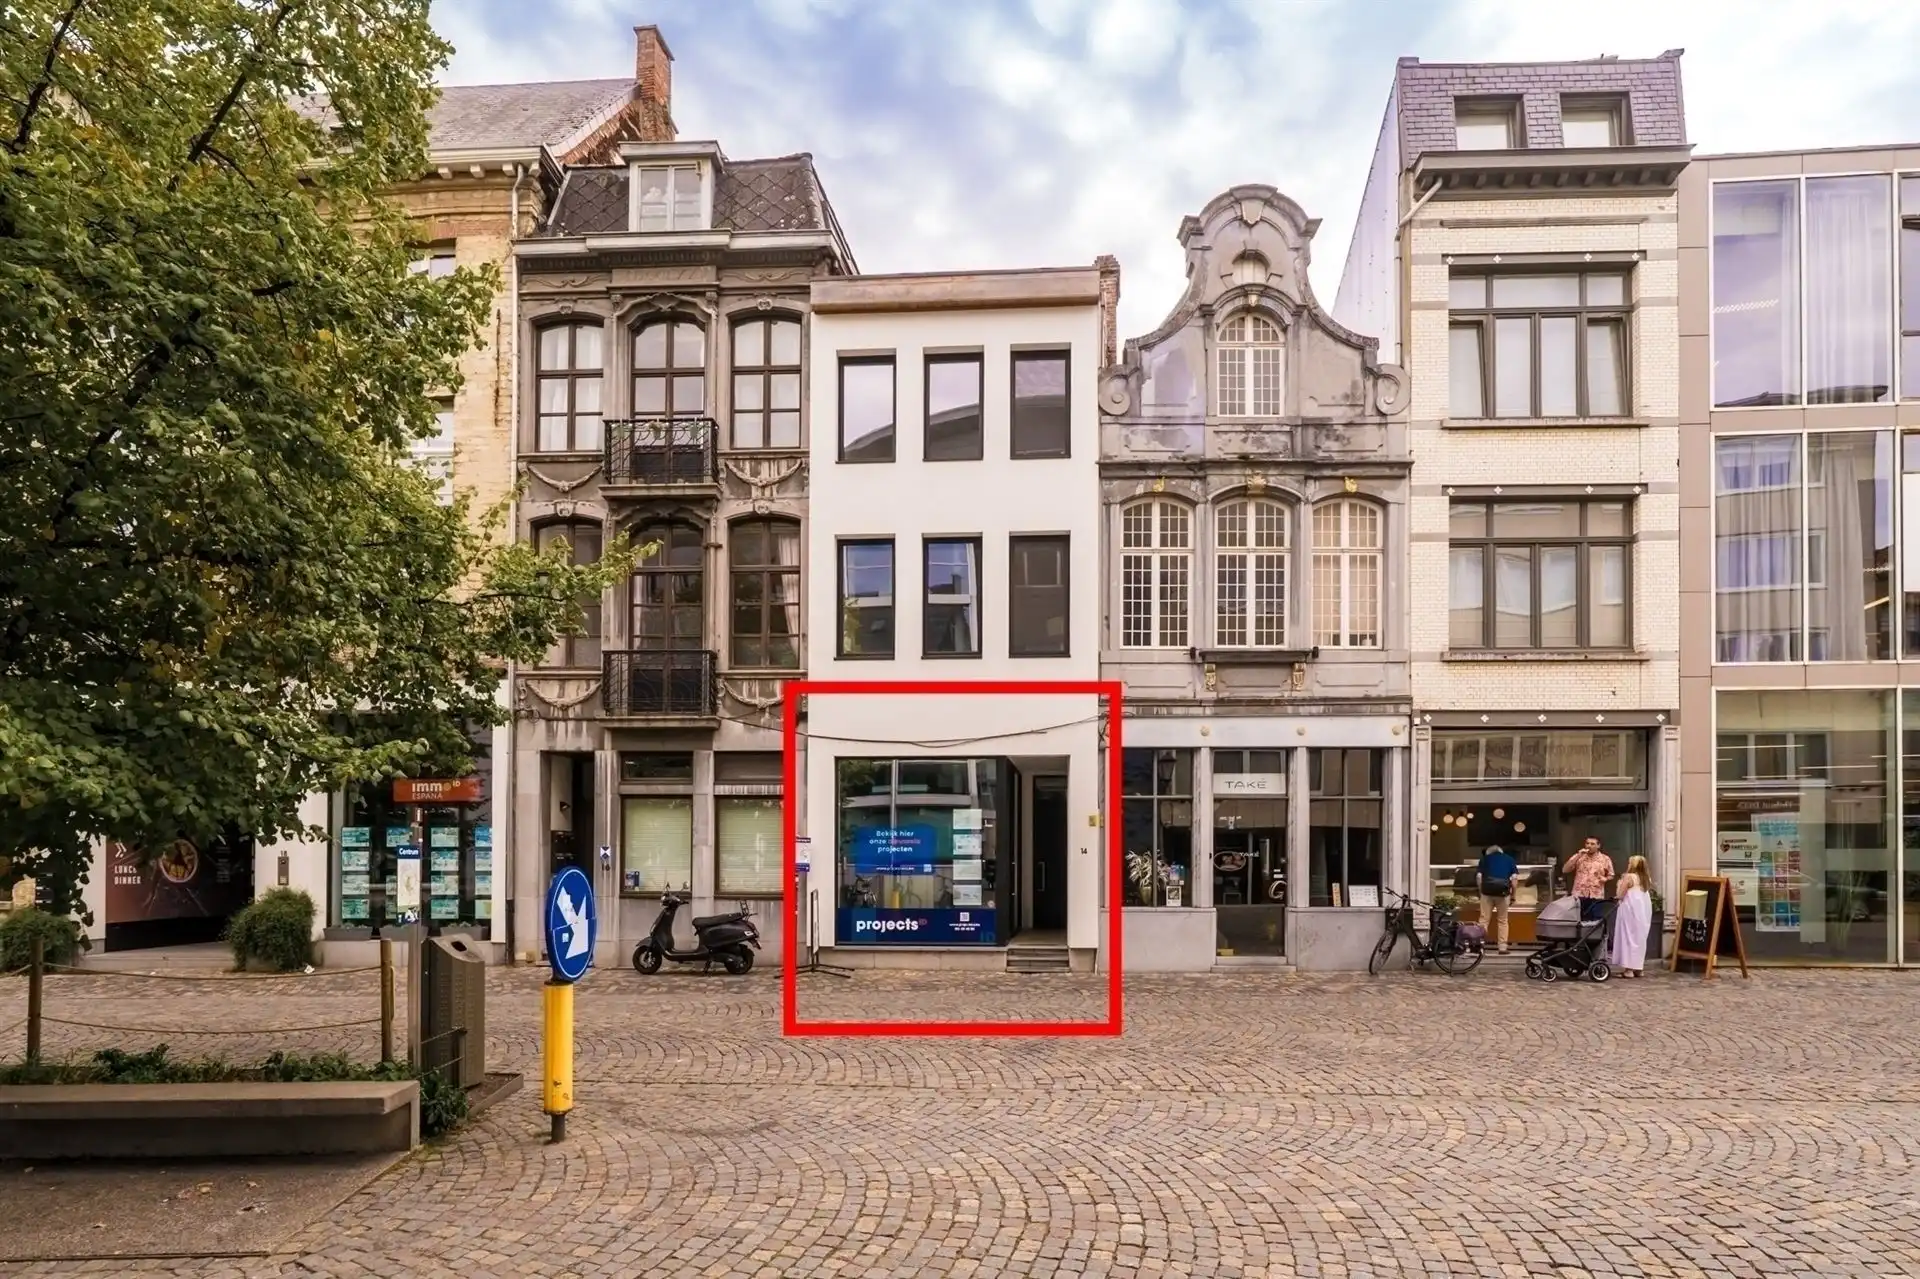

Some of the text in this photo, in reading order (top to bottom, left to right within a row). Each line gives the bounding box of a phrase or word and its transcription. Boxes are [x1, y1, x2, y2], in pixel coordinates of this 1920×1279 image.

[398, 848, 419, 856] Centrum
[877, 846, 913, 854] projecten
[1080, 847, 1088, 855] 14
[114, 876, 141, 885] DINNER
[856, 918, 919, 933] projects
